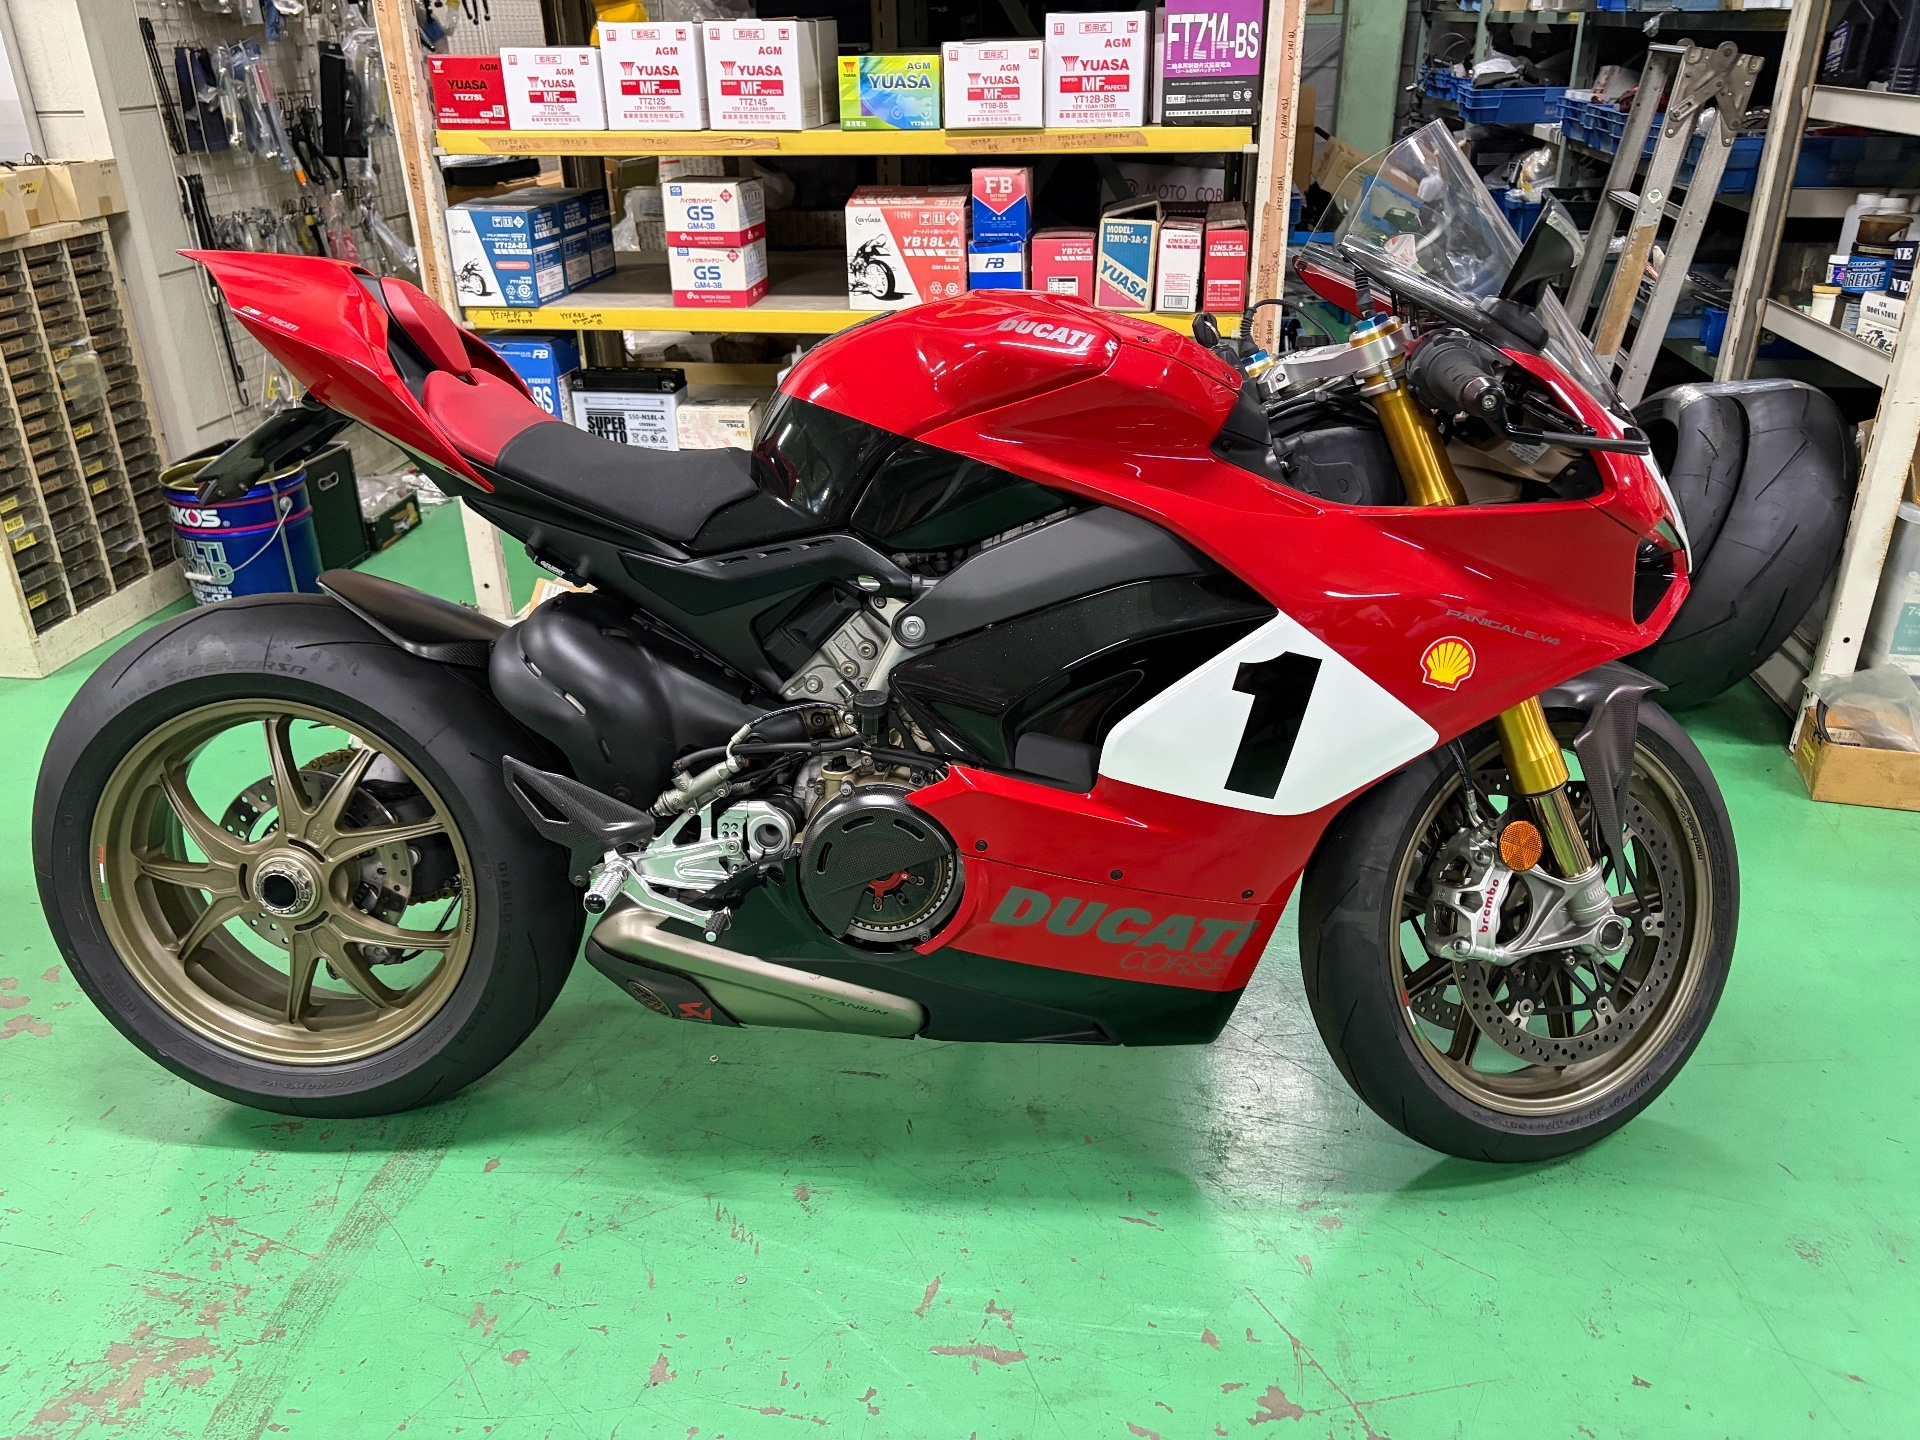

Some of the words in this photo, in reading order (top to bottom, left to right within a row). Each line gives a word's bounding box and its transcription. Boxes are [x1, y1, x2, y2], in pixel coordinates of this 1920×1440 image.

[636, 30, 656, 39] 即用式
[738, 29, 760, 39] 即用式
[1167, 12, 1259, 60] FTZ14-BS
[1104, 38, 1131, 48] AGM
[655, 46, 678, 56] AGM
[758, 46, 782, 56] AGM
[636, 65, 679, 76] YUASA
[737, 64, 783, 76] YUASA
[907, 62, 931, 70] AGM
[1000, 64, 1020, 72] AGM
[1080, 59, 1130, 71] YUASA
[555, 68, 574, 76] AGM
[447, 80, 488, 90] YUASA
[540, 79, 575, 88] YUASA
[868, 73, 931, 90] YUASA
[982, 75, 1019, 85] YUASA
[1082, 77, 1106, 91] MF
[639, 81, 660, 94] MF
[740, 81, 762, 95] MF
[543, 91, 560, 102] MF
[983, 88, 1002, 99] MF
[1074, 94, 1116, 103] YT12B-BS
[739, 98, 767, 106] TTZ14S
[984, 177, 1013, 193] FB
[1145, 184, 1187, 201] MOTO
[687, 205, 715, 221] GS
[687, 222, 716, 230] GM4-3B
[1107, 225, 1134, 234] MODEL:
[902, 236, 959, 247] YB18L-A
[1106, 234, 1148, 244] 12N10-3A-2
[1061, 247, 1091, 255] YB7C-A
[985, 257, 1004, 269] FB
[693, 266, 721, 281] GS
[1101, 260, 1147, 302] YUASA
[267, 316, 300, 332] DUCATI
[996, 319, 1096, 348] DUCATI
[533, 349, 549, 359] FB
[587, 416, 627, 430] SUPER
[1540, 633, 1561, 646] V4
[1225, 650, 1322, 799] 1
[1478, 878, 1500, 934] brembo
[989, 885, 1262, 956] DUCATI
[1120, 951, 1231, 978] CORSE
[809, 993, 890, 1016] TITANIUM
